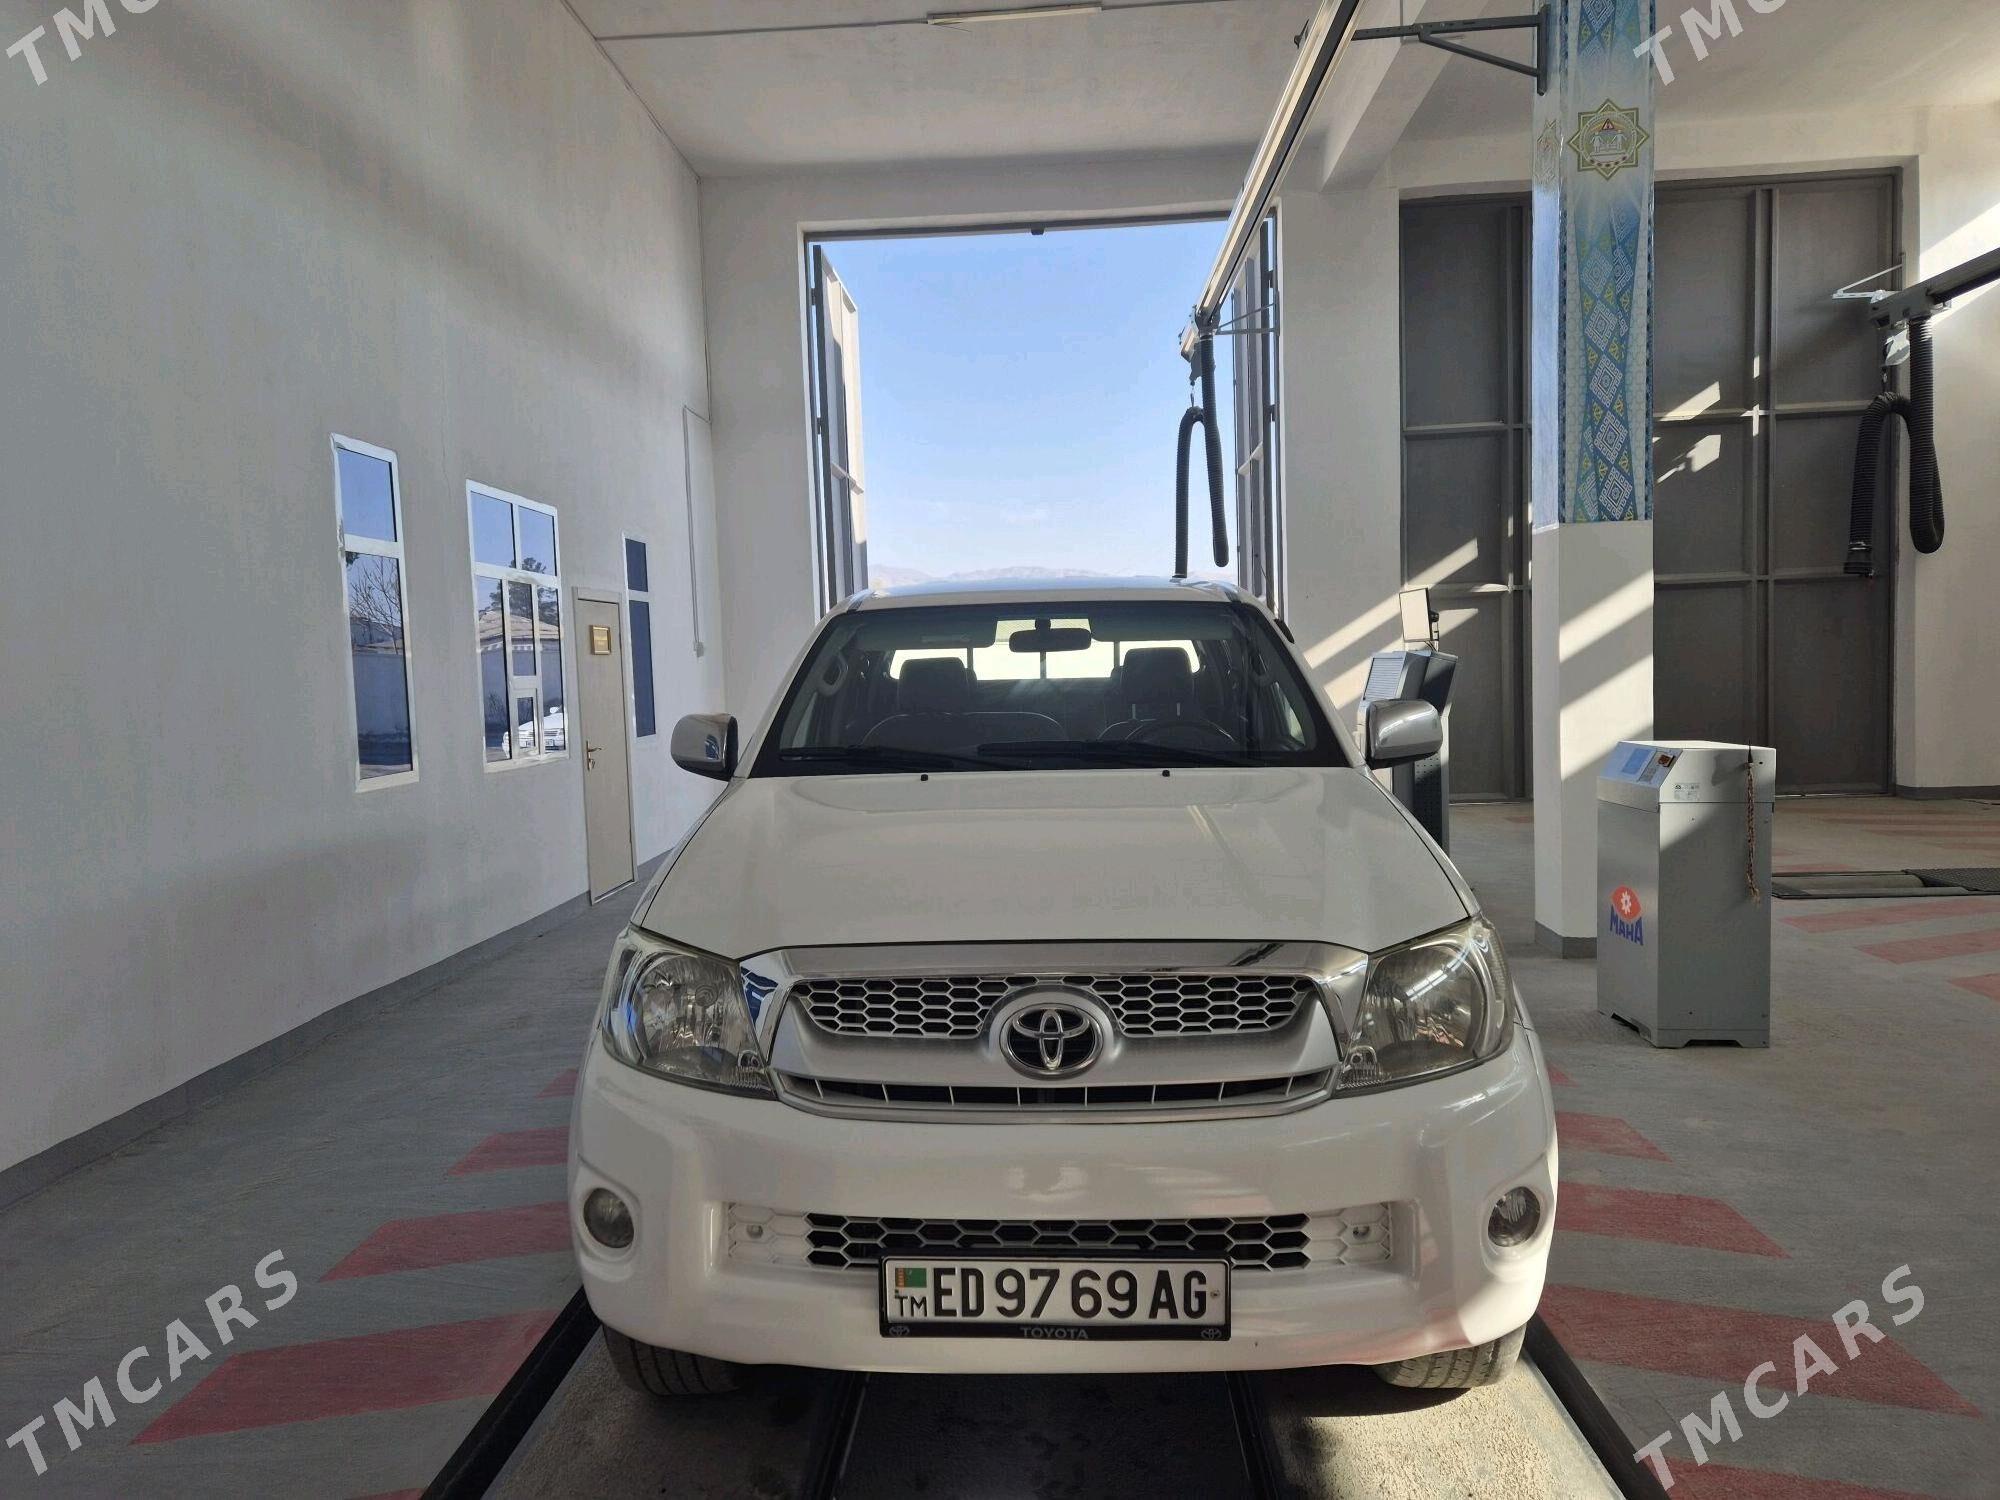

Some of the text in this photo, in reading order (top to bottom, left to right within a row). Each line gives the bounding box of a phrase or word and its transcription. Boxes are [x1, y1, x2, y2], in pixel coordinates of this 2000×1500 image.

[1609, 903, 1644, 946] MAHA
[895, 1295, 927, 1317] TM
[1020, 1326, 1089, 1340] TOYOTA
